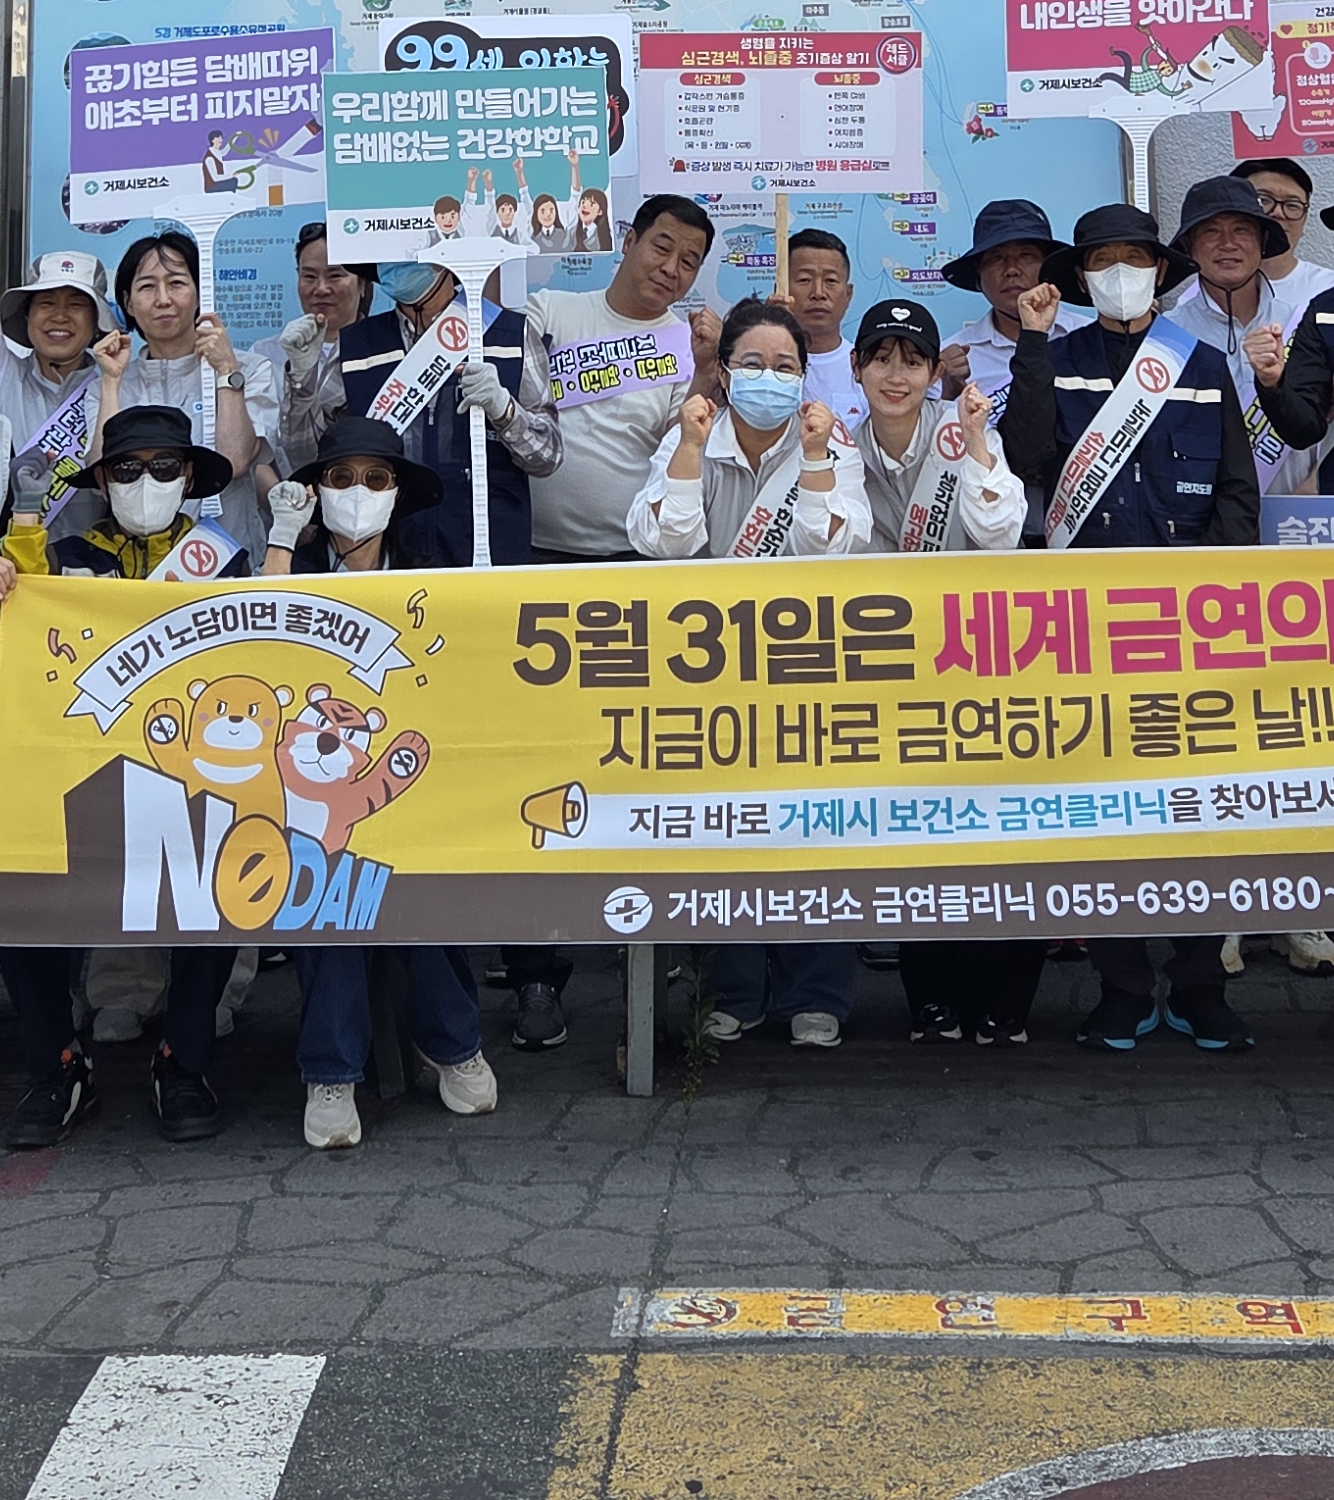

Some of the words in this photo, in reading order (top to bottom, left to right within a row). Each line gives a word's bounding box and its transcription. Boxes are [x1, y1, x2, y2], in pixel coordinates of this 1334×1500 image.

[739, 36, 776, 50] 생명을
[778, 36, 815, 50] 지키는
[885, 42, 909, 55] 레드
[680, 51, 745, 67] 심근경색,
[747, 51, 793, 66] 뇌졸중
[795, 51, 843, 66] 조기증상
[845, 50, 870, 65] 알기
[84, 57, 200, 96] 끊기힘든
[203, 45, 320, 88] 담배따위
[693, 73, 732, 85] 심근경색
[832, 73, 861, 85] 뇌졸중
[1037, 77, 1105, 92] 거제시보건소
[84, 94, 200, 132] 애초부터
[203, 86, 322, 122] 피지말자
[331, 88, 450, 126] 우리함께
[454, 84, 600, 121] 만들어가는
[332, 128, 451, 166] 담배없는
[455, 124, 602, 162] 건강한학교
[690, 160, 710, 173] 증상
[711, 160, 732, 172] 발생
[733, 160, 753, 172] 즉시
[784, 160, 815, 172] 가능한
[815, 159, 837, 172] 병원
[101, 175, 171, 193] 거제시보건소
[769, 178, 817, 189] 거제시보건소
[363, 216, 437, 233] 거제시보건소
[218, 268, 258, 281] 해안비경
[103, 640, 161, 691] 네가
[164, 589, 279, 651] 노담이면
[283, 596, 371, 655] 좋겠어
[512, 599, 650, 689] 5월
[667, 592, 916, 688] 31일은
[932, 585, 1092, 679] 세계
[598, 703, 761, 772] 지금이
[775, 701, 881, 768] 바로
[897, 694, 1113, 764] 금연하기
[1129, 688, 1240, 758] 좋은
[627, 804, 697, 838] 지금
[703, 801, 770, 836] 바로
[777, 798, 880, 839] 거제시
[887, 795, 990, 834] 보건소
[996, 786, 1204, 830] 금연클리닉을
[666, 885, 865, 928] 거제시보건소
[871, 879, 1037, 923] 금연클리닉
[782, 1292, 1306, 1337] 금연구역
